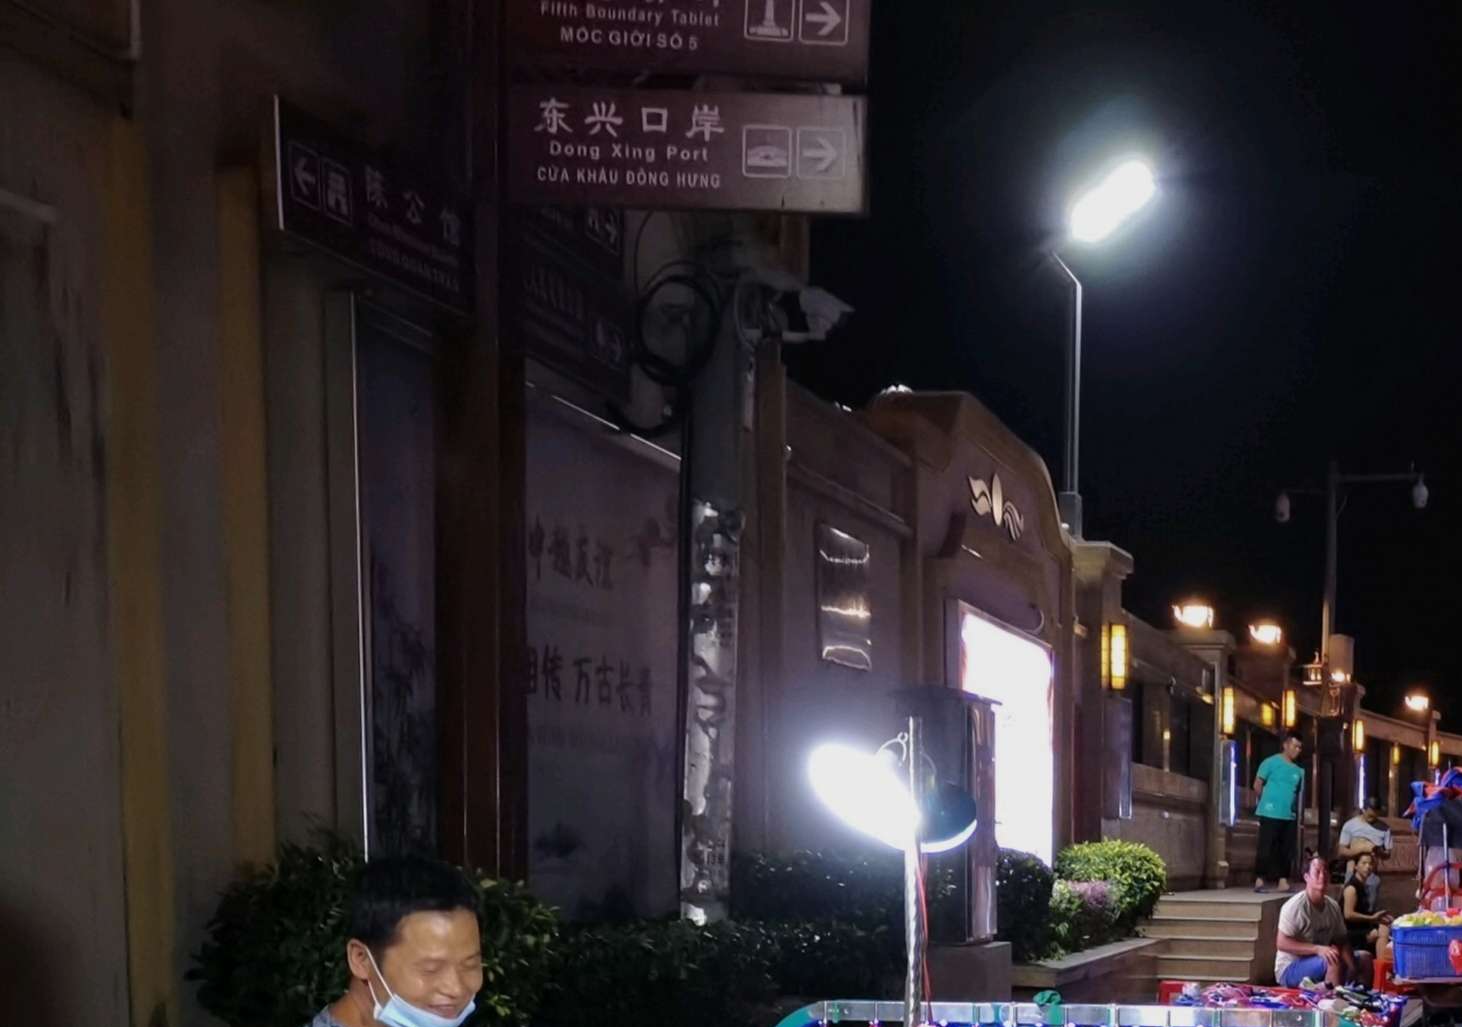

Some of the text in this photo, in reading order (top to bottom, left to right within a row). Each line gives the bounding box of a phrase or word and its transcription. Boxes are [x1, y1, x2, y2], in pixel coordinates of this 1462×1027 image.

[586, 3, 662, 27] Boundary
[672, 9, 719, 26] Tablet
[688, 35, 699, 50] 5
[533, 97, 725, 141] 东兴口岸
[550, 140, 709, 162] Dong Xing Port
